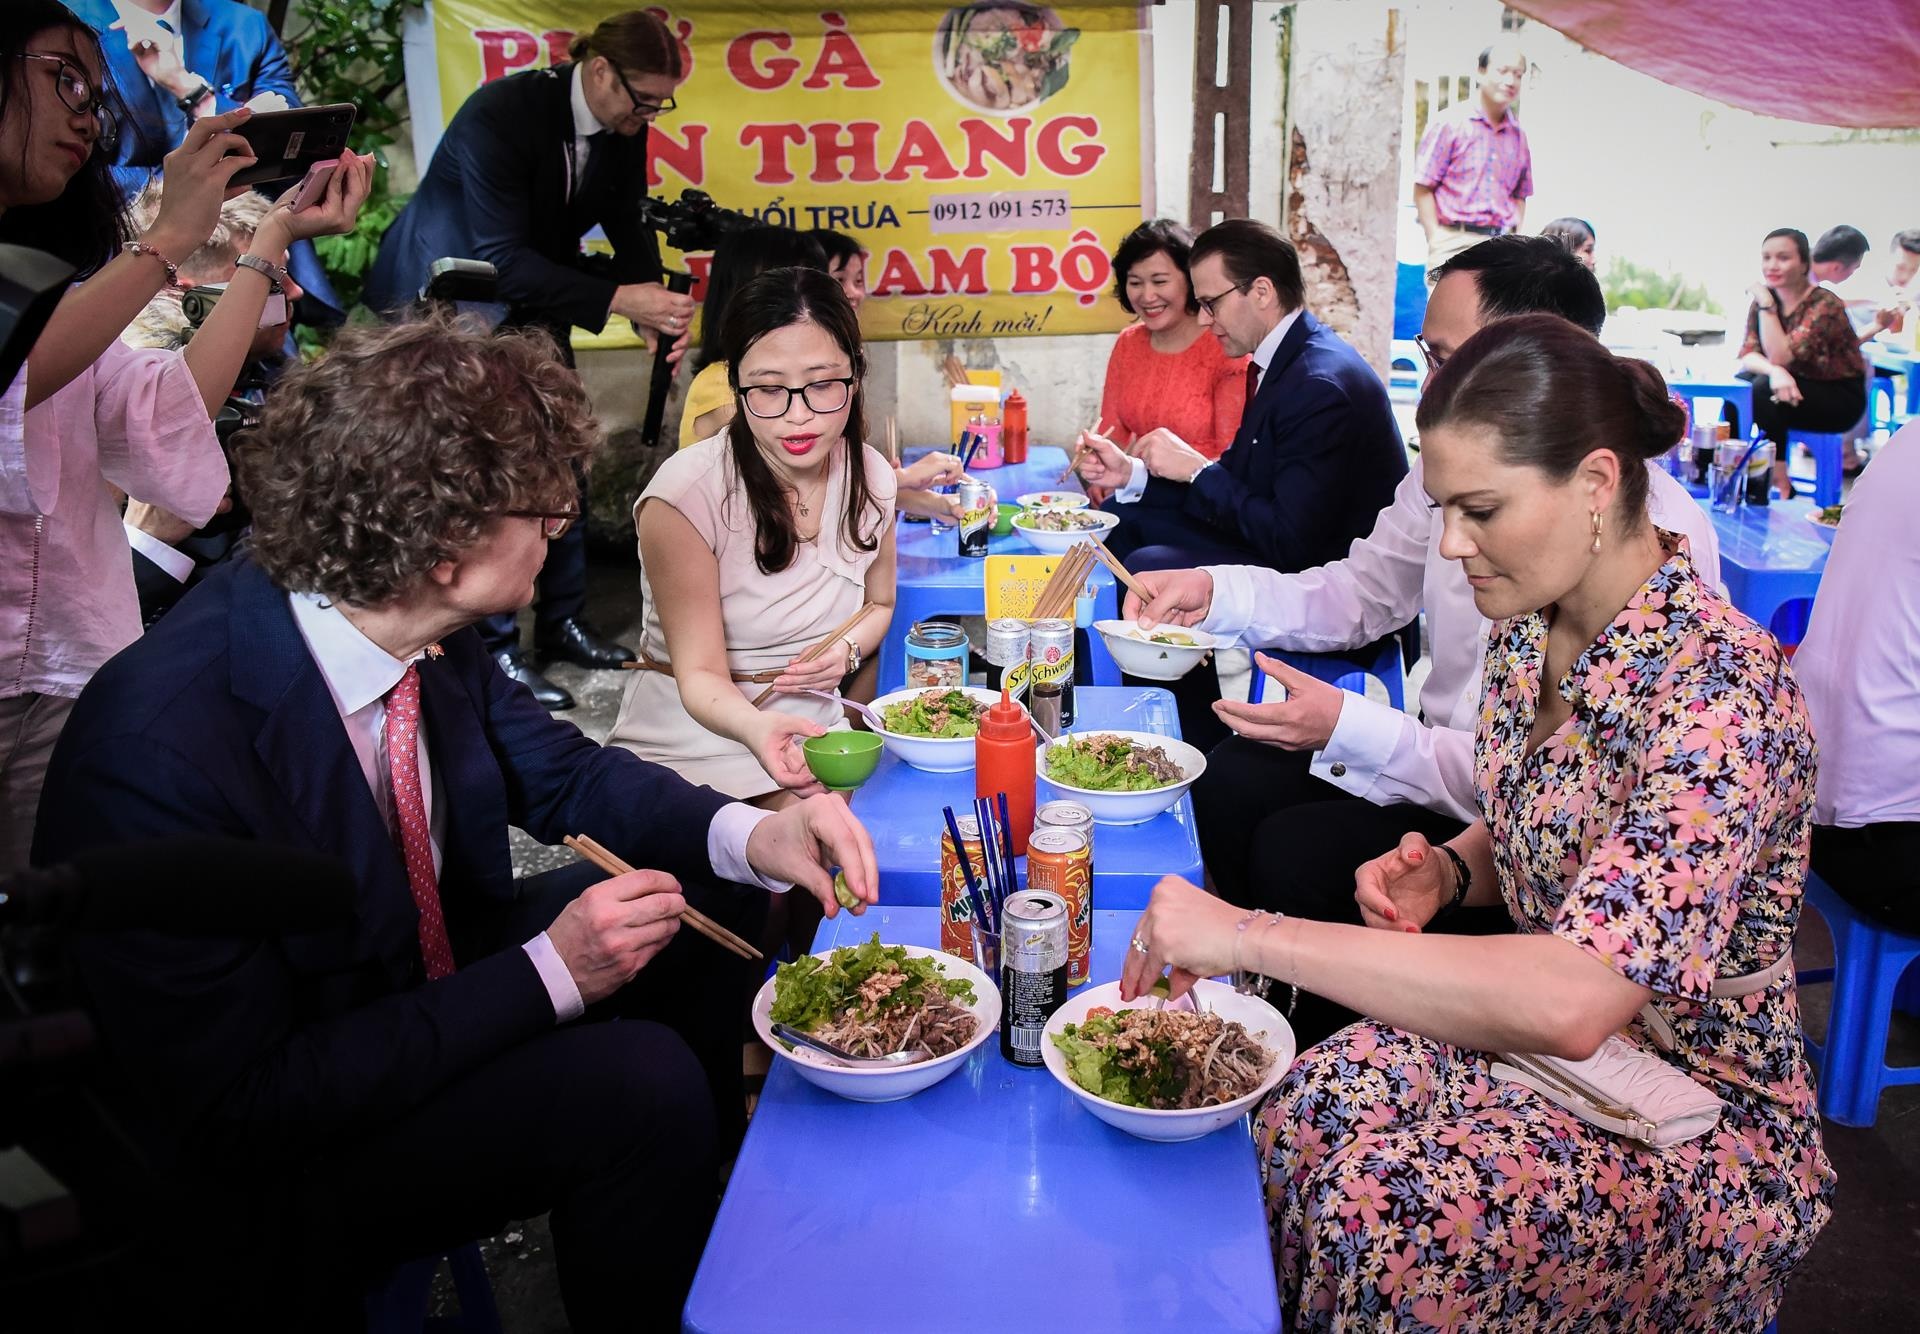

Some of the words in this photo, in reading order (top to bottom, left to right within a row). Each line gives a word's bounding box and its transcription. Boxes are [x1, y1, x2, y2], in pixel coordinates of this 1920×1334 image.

[728, 12, 880, 89] GÀ
[741, 116, 1106, 184] THANG
[805, 201, 900, 229] TRƯA
[934, 202, 981, 221] 0912
[989, 201, 1023, 220] 091
[1032, 198, 1067, 218] 573
[862, 248, 988, 296] AM
[1011, 230, 1111, 305] BỘ
[902, 303, 982, 336] Kính
[992, 305, 1053, 333] mời!
